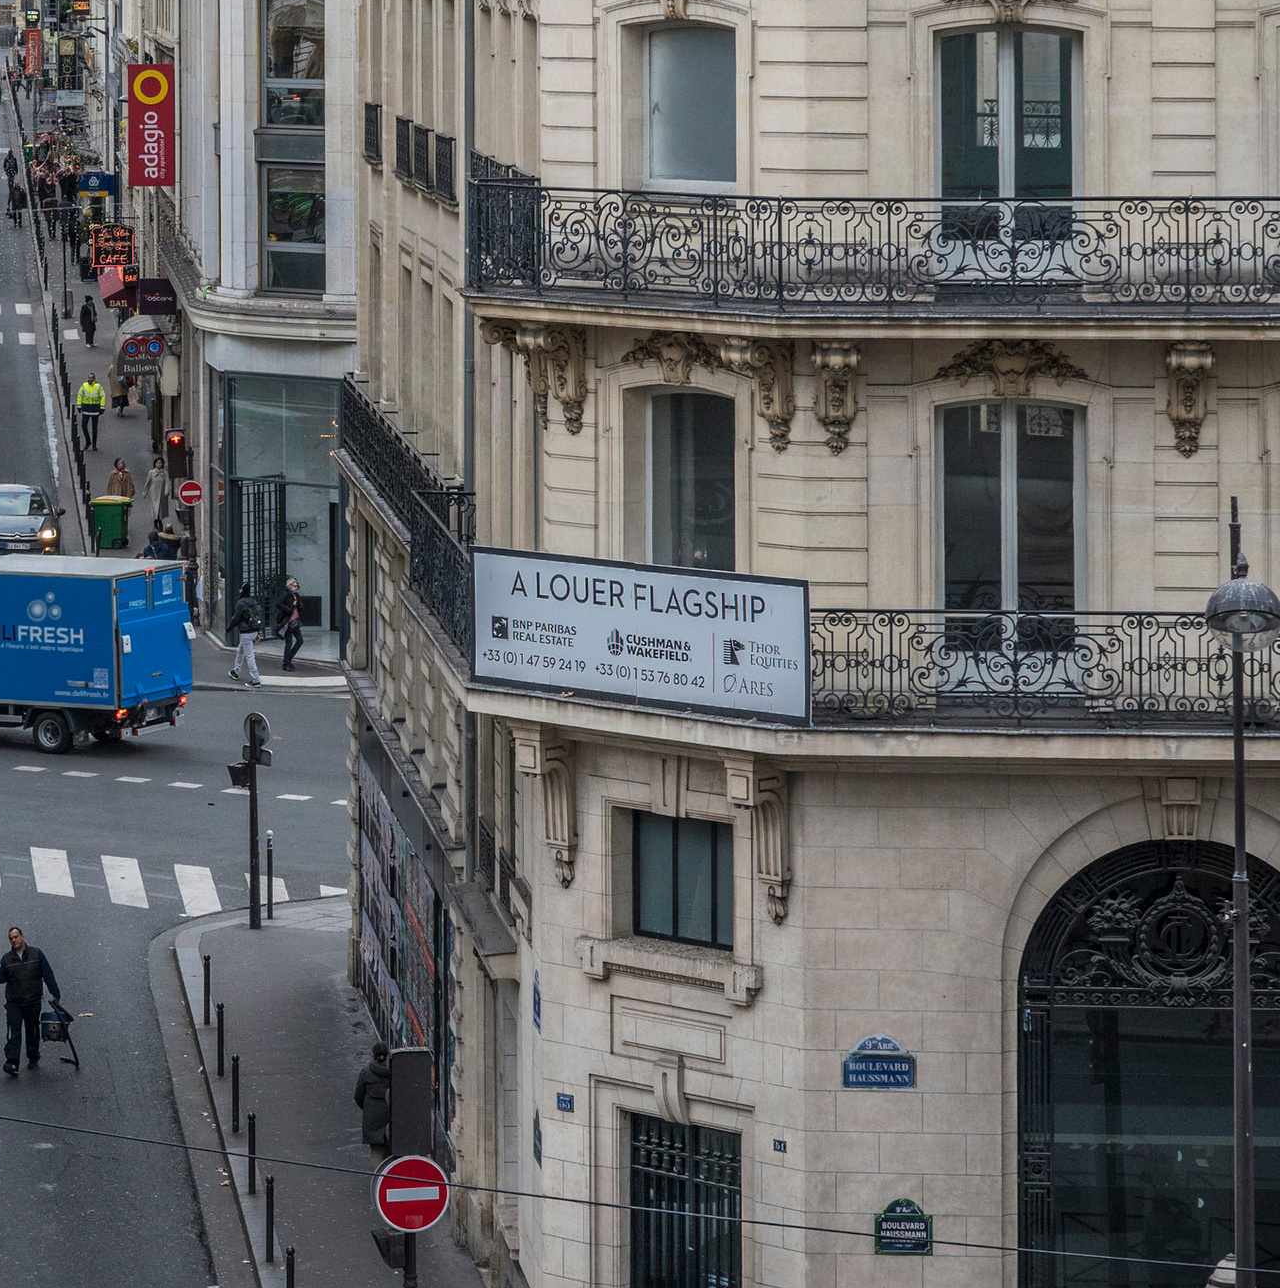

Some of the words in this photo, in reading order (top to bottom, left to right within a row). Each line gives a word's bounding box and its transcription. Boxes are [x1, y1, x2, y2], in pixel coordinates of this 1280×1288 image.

[138, 111, 164, 178] adagio
[511, 570, 528, 597] A
[536, 572, 625, 608] LOUER
[634, 582, 765, 623] FLAGSHIP
[513, 619, 533, 631] BNP
[535, 622, 577, 636] PARIBAS
[513, 631, 538, 643] REAL
[540, 634, 574, 648] ESTATE
[626, 634, 682, 651] CUSHMAN
[684, 641, 691, 651] &
[748, 641, 781, 655] THOR
[482, 649, 500, 661] +33
[503, 651, 517, 665] (0)
[526, 654, 540, 666] 47
[543, 657, 556, 668] 59
[559, 658, 572, 670] 24
[575, 660, 586, 672] 19
[626, 645, 689, 662] WAKEFIELD
[750, 654, 798, 670] EQUITIES
[595, 664, 613, 676] +33
[616, 665, 630, 679] (0)
[641, 669, 654, 682] 53
[658, 671, 670, 684] 76
[673, 673, 688, 686] 80
[691, 675, 705, 688] 42
[55, 689, 109, 698] www.delifresh.fr
[739, 678, 774, 697] ARES
[849, 1063, 908, 1071] BOULEVARD
[849, 1074, 909, 1082] HAUSSMANN
[882, 1222, 925, 1230] BOULEVARD
